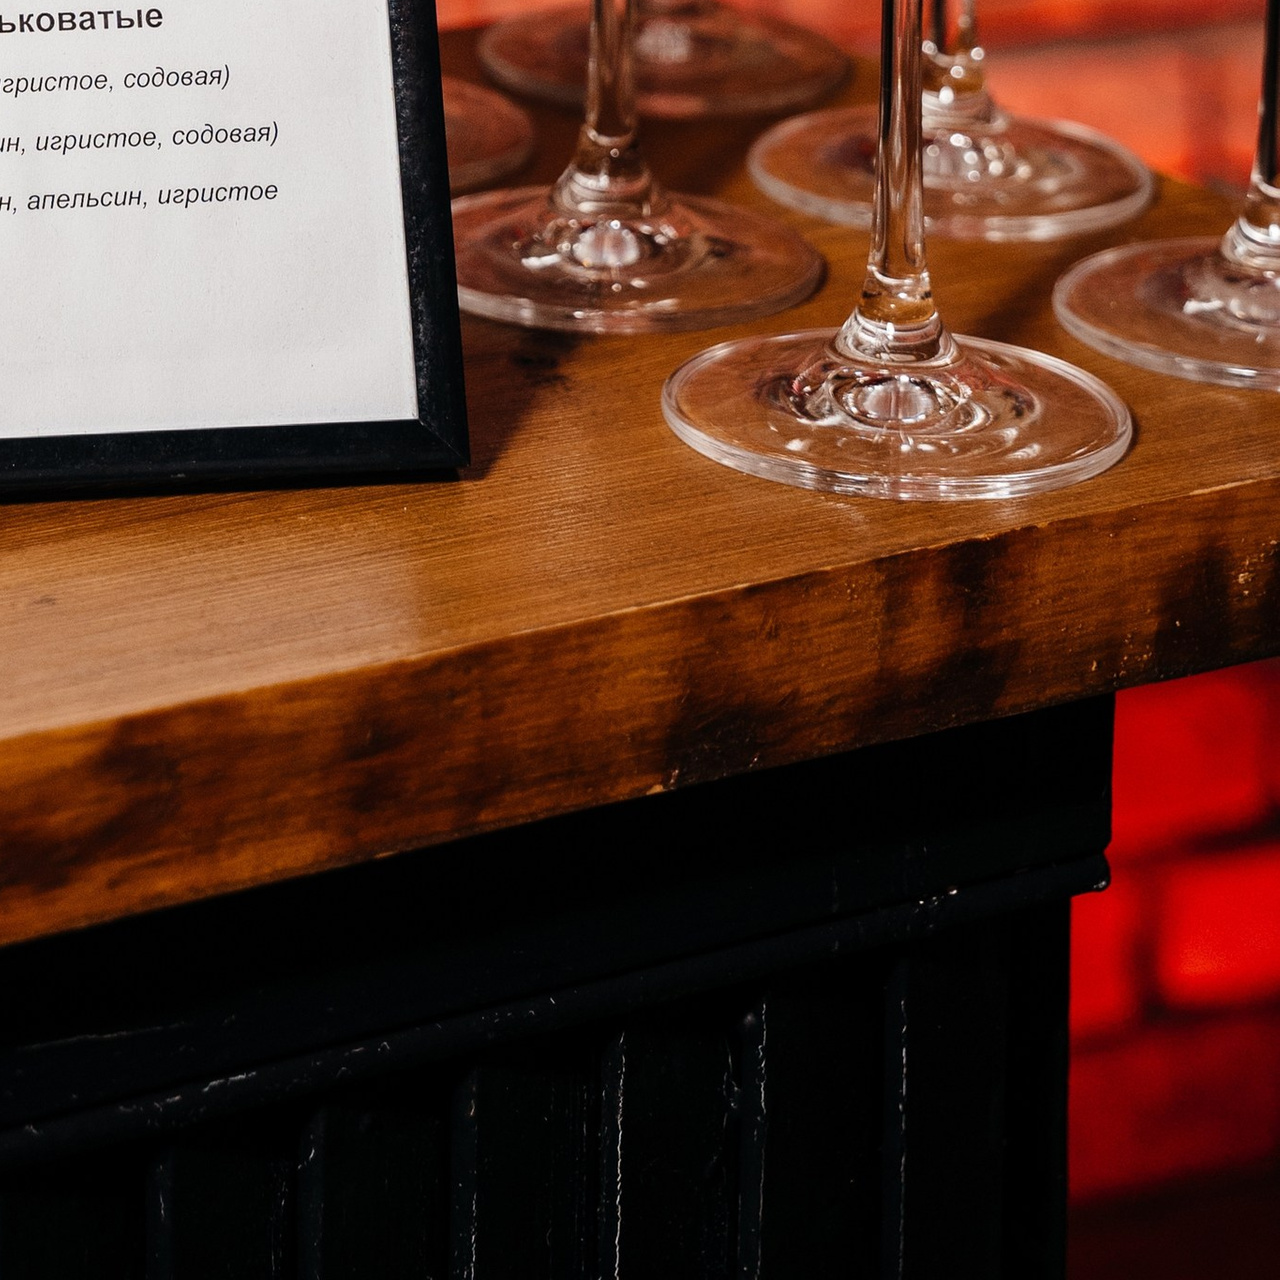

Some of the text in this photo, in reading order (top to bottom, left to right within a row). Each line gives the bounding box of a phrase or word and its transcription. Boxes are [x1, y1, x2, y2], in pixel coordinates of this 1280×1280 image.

[123, 63, 230, 91] содовая)
[35, 130, 162, 156] игристое,
[172, 120, 279, 147] содовая)
[26, 189, 148, 211] апельсин,
[157, 184, 279, 209] игристое
